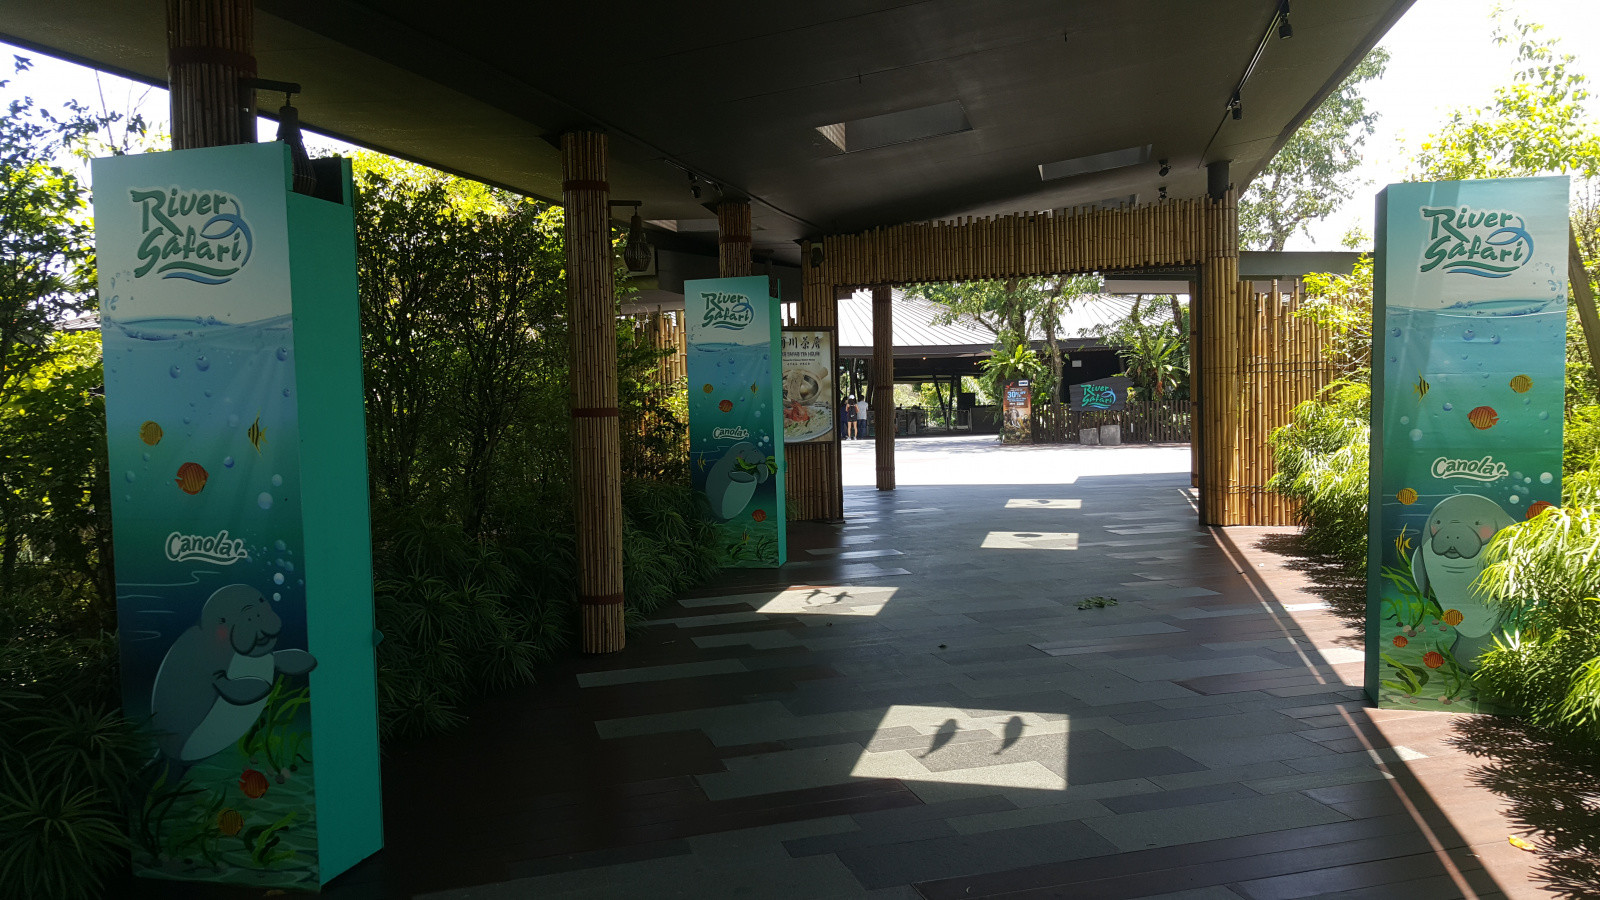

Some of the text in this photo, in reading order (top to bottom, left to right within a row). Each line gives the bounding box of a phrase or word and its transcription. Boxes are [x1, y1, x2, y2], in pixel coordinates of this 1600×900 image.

[130, 188, 227, 236] River
[1422, 208, 1513, 244] River
[134, 225, 241, 278] Safari
[1421, 235, 1523, 273] Safari
[701, 292, 743, 311] River
[702, 307, 749, 328] Safari
[1081, 384, 1109, 396] River
[1081, 394, 1113, 407] Safari
